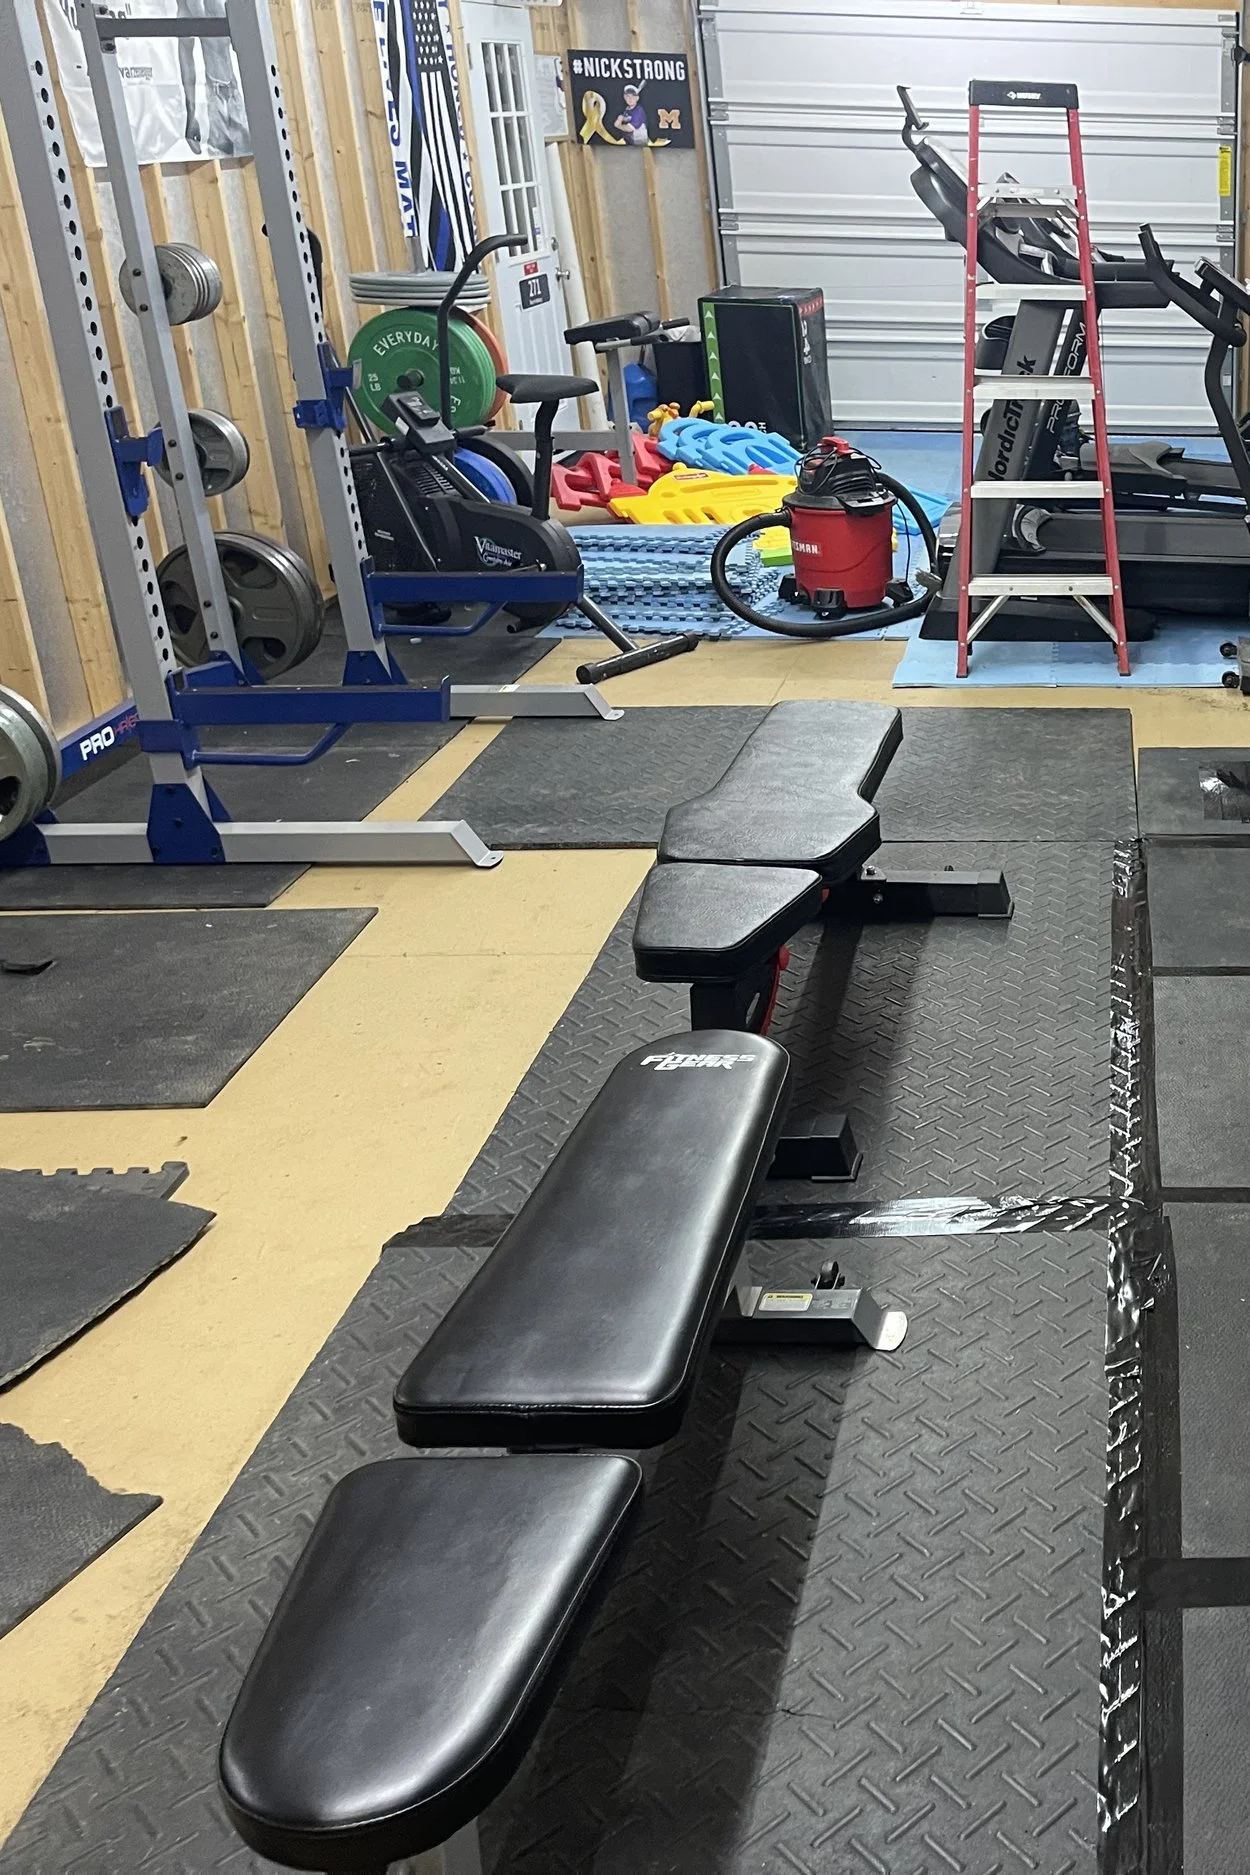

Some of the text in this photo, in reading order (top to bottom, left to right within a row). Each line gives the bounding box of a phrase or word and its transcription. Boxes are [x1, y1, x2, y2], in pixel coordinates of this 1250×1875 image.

[572, 56, 686, 81] #NICKSTRONG
[657, 108, 681, 129] M
[373, 331, 440, 356] EVERYDAY
[80, 726, 115, 761] PRO
[640, 1052, 757, 1066] FITNESS
[654, 1057, 734, 1071] GEAR
